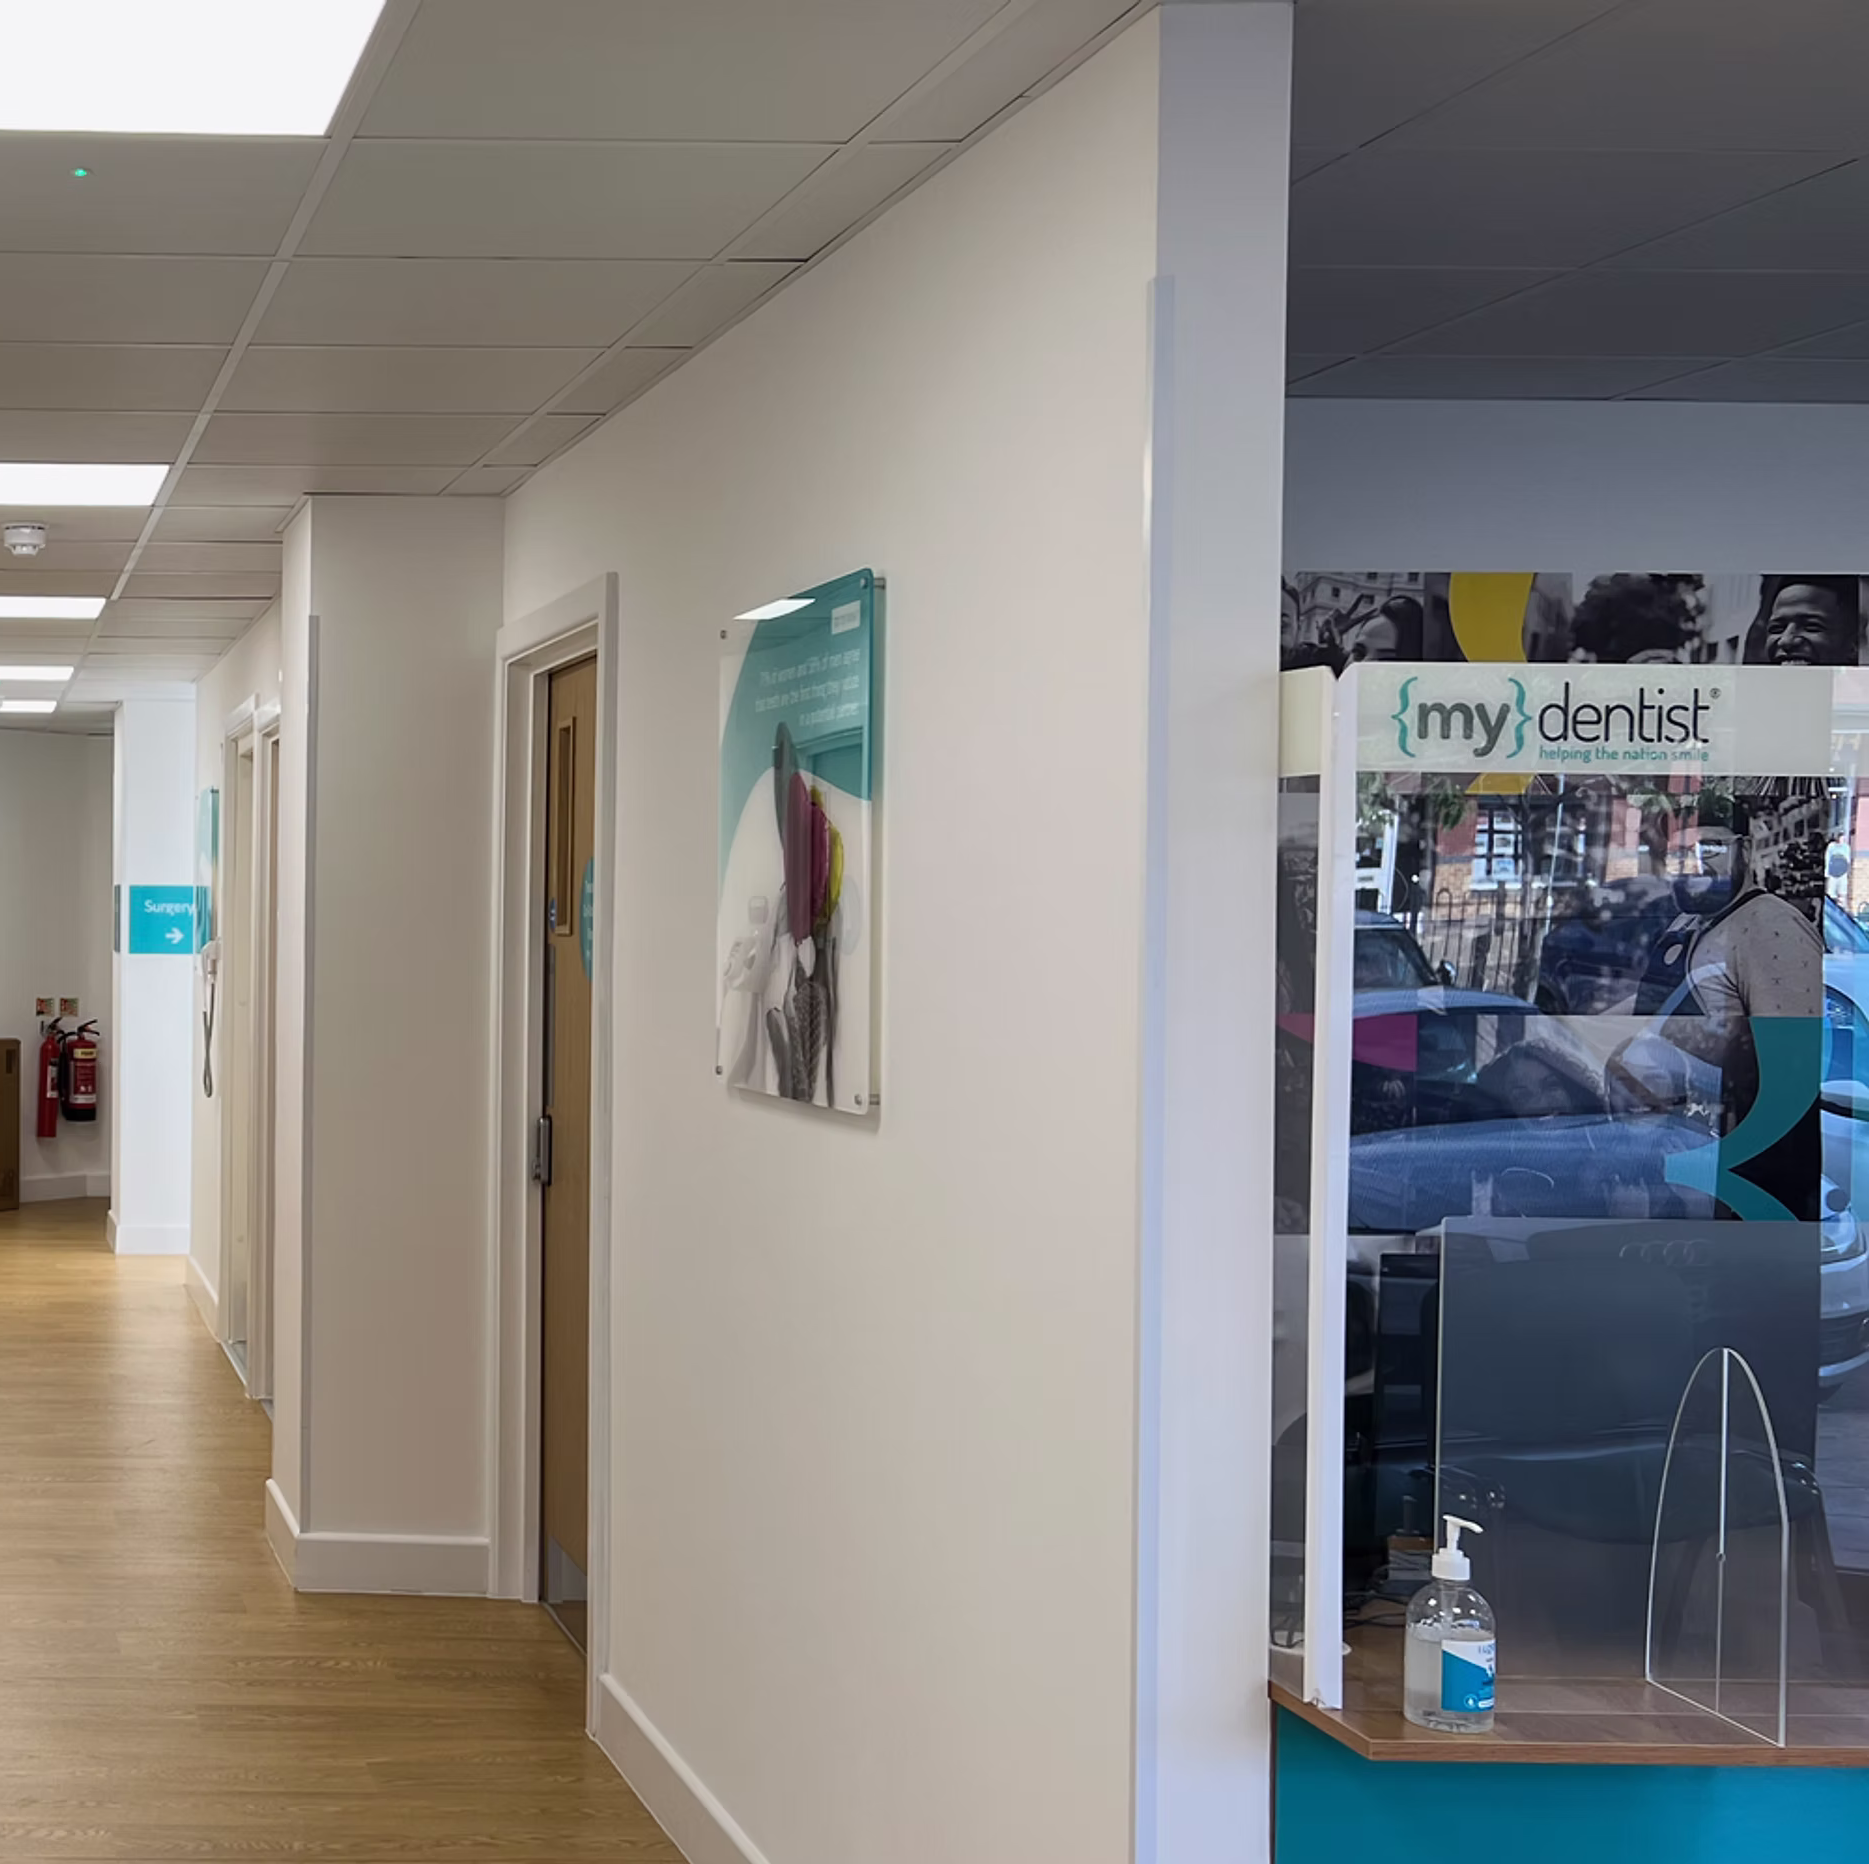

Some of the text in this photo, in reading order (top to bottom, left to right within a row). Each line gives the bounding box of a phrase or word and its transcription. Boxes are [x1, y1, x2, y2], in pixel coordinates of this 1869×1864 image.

[1539, 746, 1591, 763] helping
[1595, 746, 1618, 760] the
[1622, 747, 1667, 760] nation
[144, 899, 197, 916] Surgery
